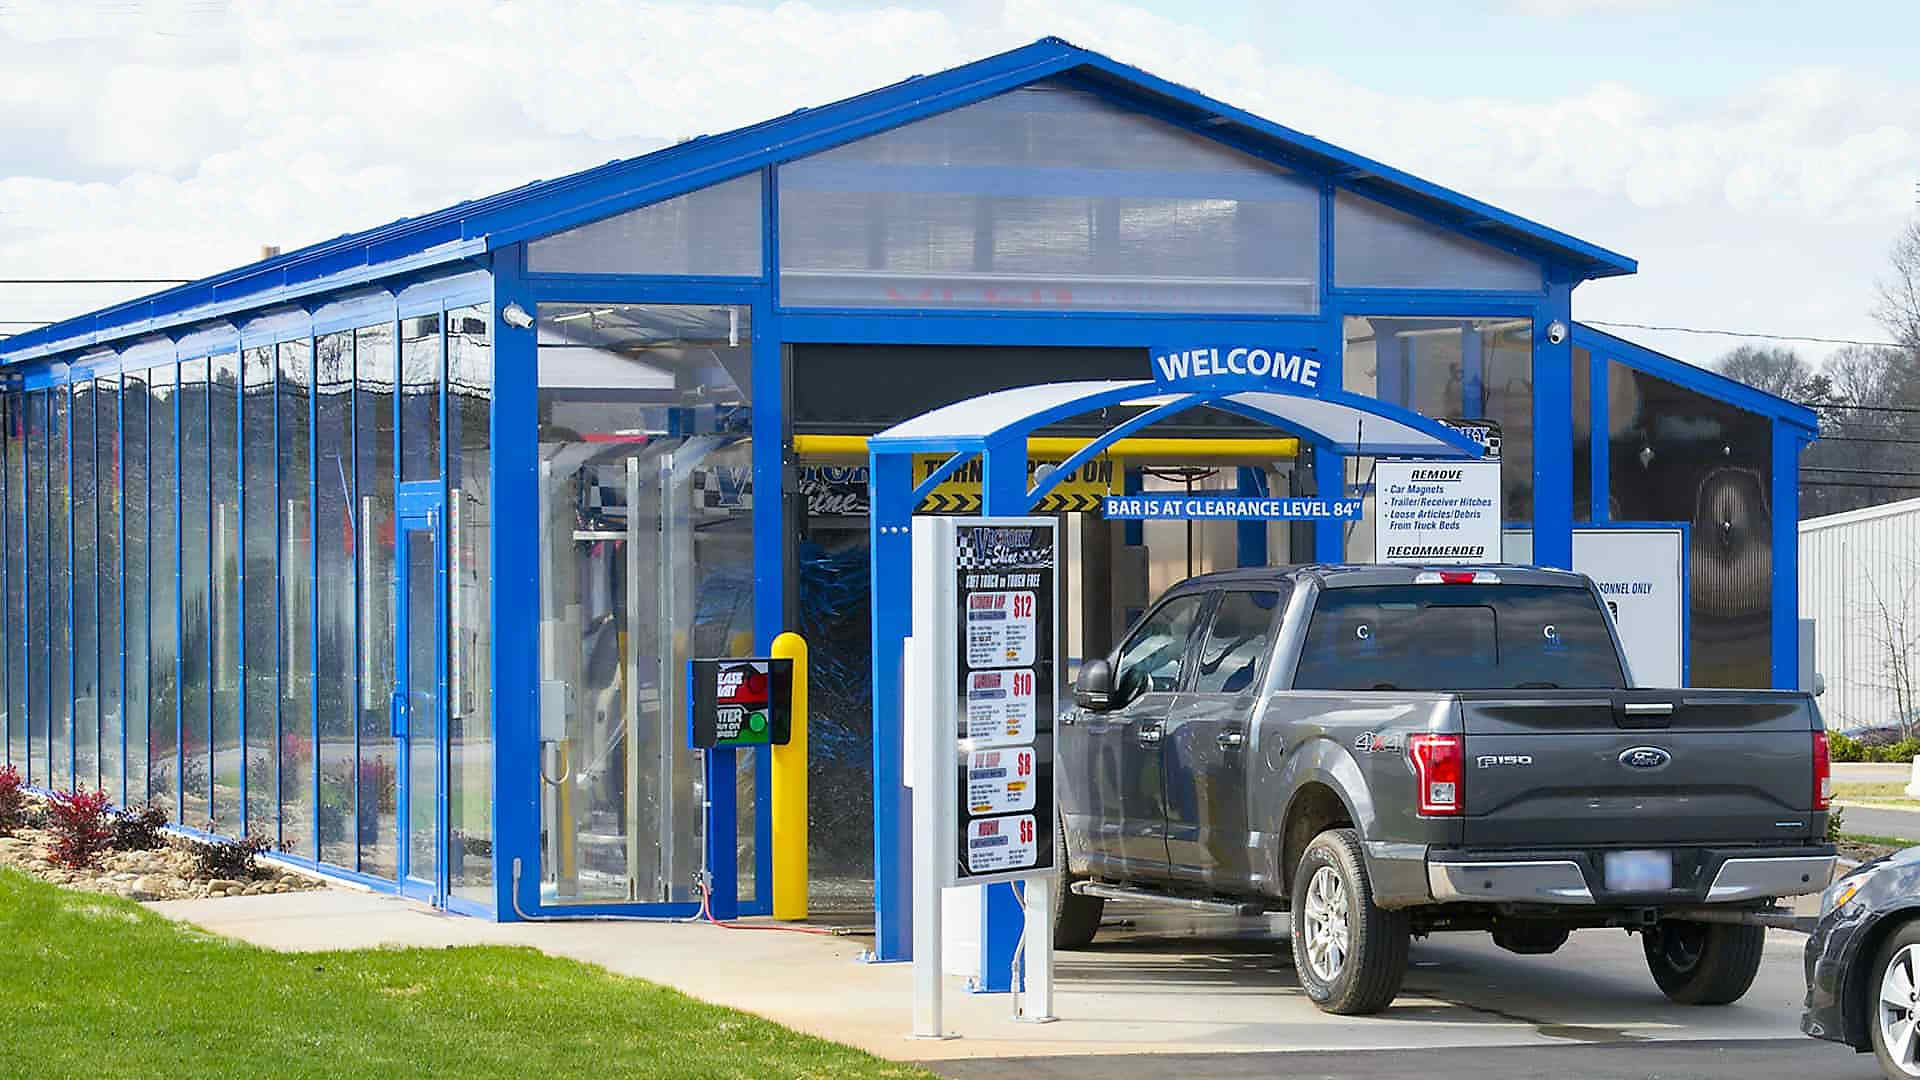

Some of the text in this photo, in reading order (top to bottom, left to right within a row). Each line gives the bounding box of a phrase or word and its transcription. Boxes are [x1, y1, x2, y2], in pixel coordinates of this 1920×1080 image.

[1157, 348, 1321, 388] WELCOME
[1411, 470, 1462, 480] REMOVE
[1390, 485, 1444, 496] Car Magnets
[1108, 500, 1139, 516] BAR
[1144, 501, 1158, 516] IS
[1163, 501, 1187, 516] AT
[1185, 501, 1279, 516] CLEARANCE
[1283, 502, 1330, 516] LEVEL
[1391, 498, 1492, 507] Trailer/Receiver Hitches
[1390, 510, 1481, 519] Loose Articles/Debris
[1389, 521, 1460, 530] From Truck Beds
[1387, 546, 1484, 556] RECOMMENDED
[1632, 582, 1653, 594] ONLY
[1014, 594, 1032, 619] $12
[1014, 672, 1032, 696] $10
[1017, 752, 1031, 776] $8
[1632, 751, 1661, 767] Ford
[1020, 819, 1033, 844] $6
